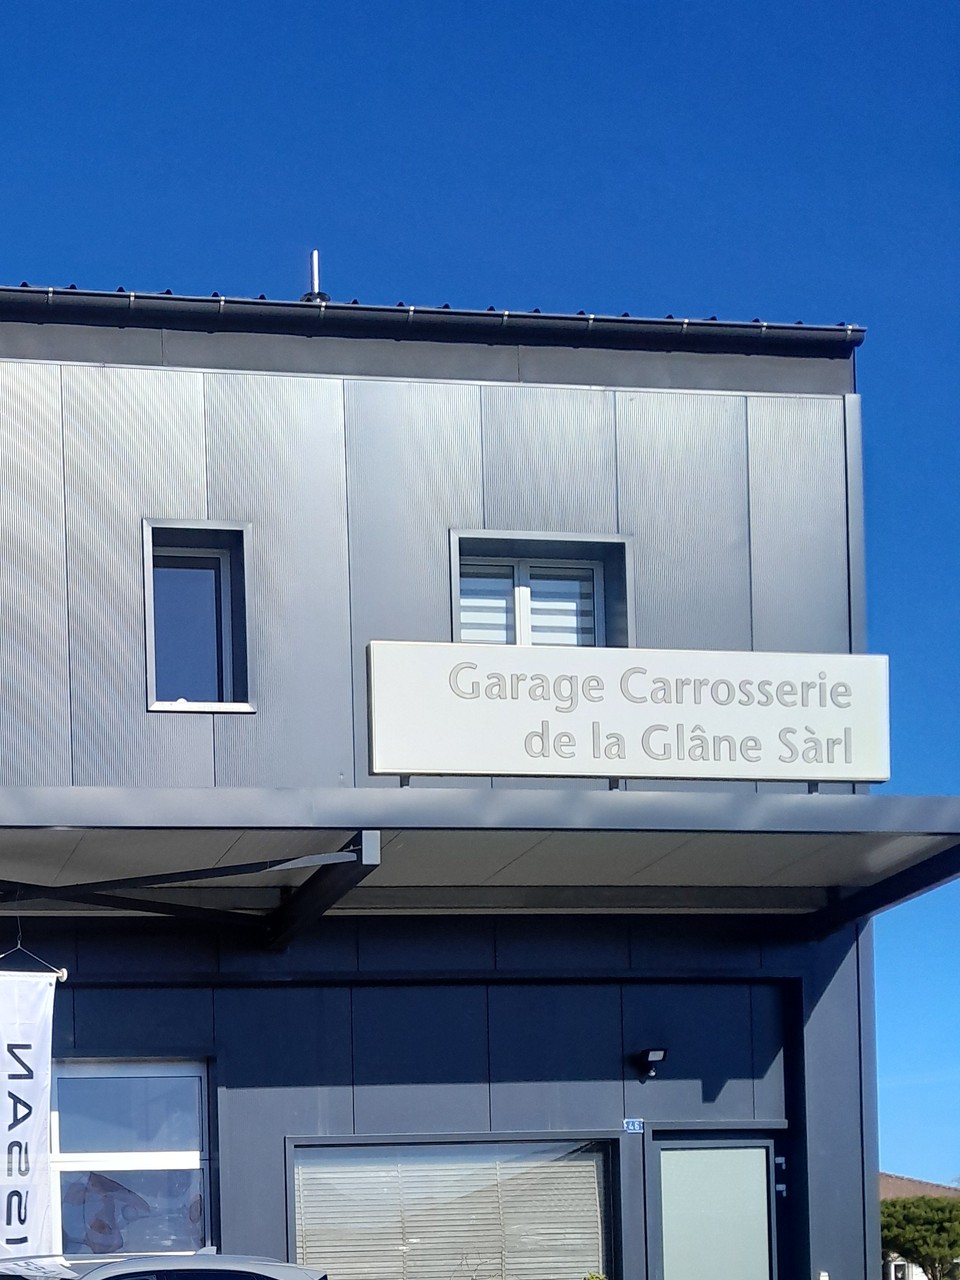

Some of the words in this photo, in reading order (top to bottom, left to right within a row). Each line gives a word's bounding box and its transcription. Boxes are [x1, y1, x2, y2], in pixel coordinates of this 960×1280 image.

[449, 661, 605, 713] Garage
[620, 666, 852, 708] Carrosserie
[524, 720, 576, 759] de
[592, 721, 626, 760] la
[641, 723, 762, 763] Glâne
[778, 725, 852, 764] Sàrl
[628, 1121, 640, 1130] 46
